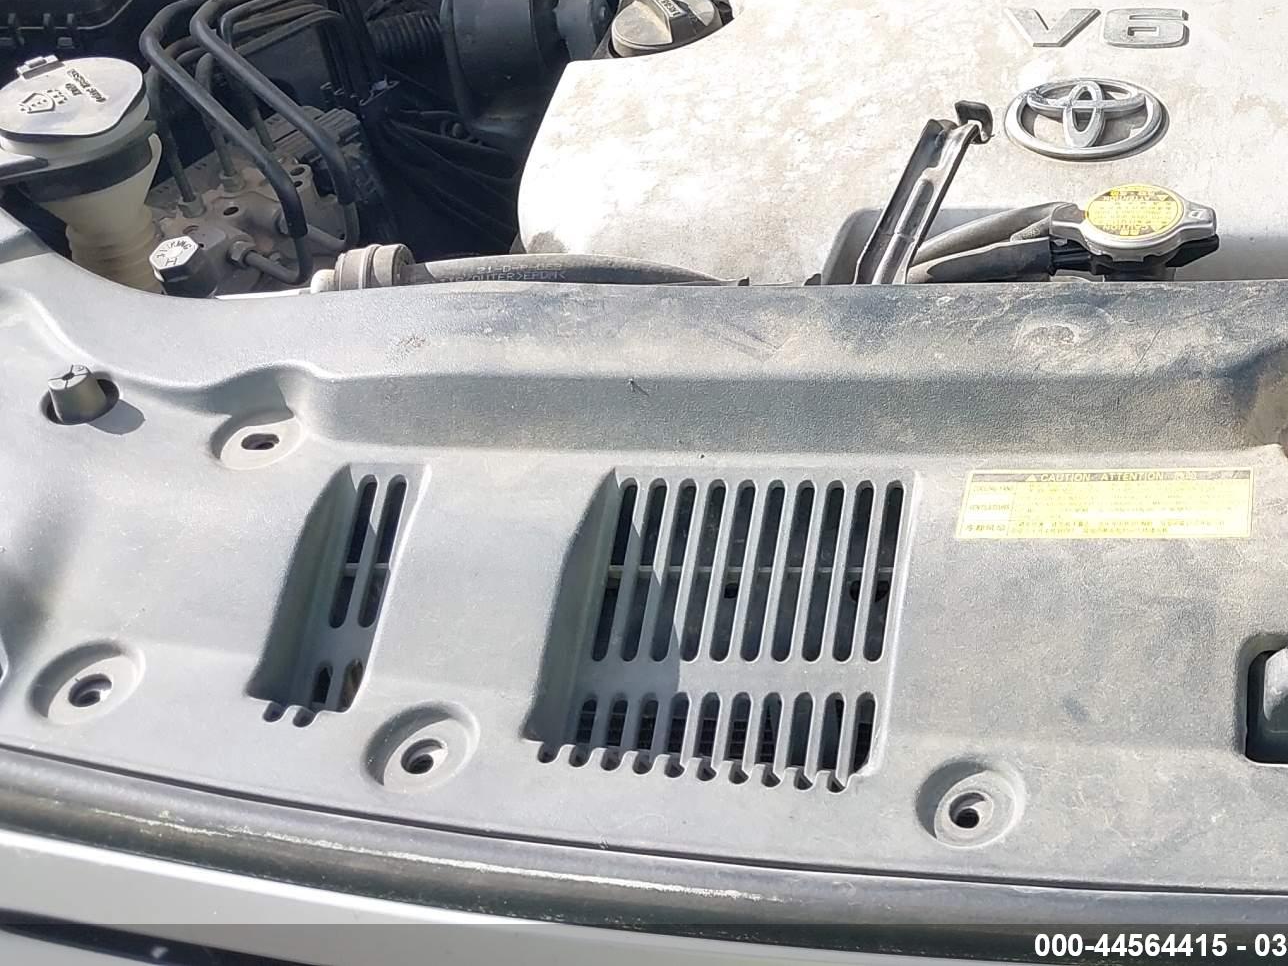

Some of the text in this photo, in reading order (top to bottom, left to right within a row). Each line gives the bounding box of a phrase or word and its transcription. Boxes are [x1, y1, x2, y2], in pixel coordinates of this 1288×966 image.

[1006, 7, 1189, 49] V6
[1040, 472, 1163, 482] CAUTION ATTENTION
